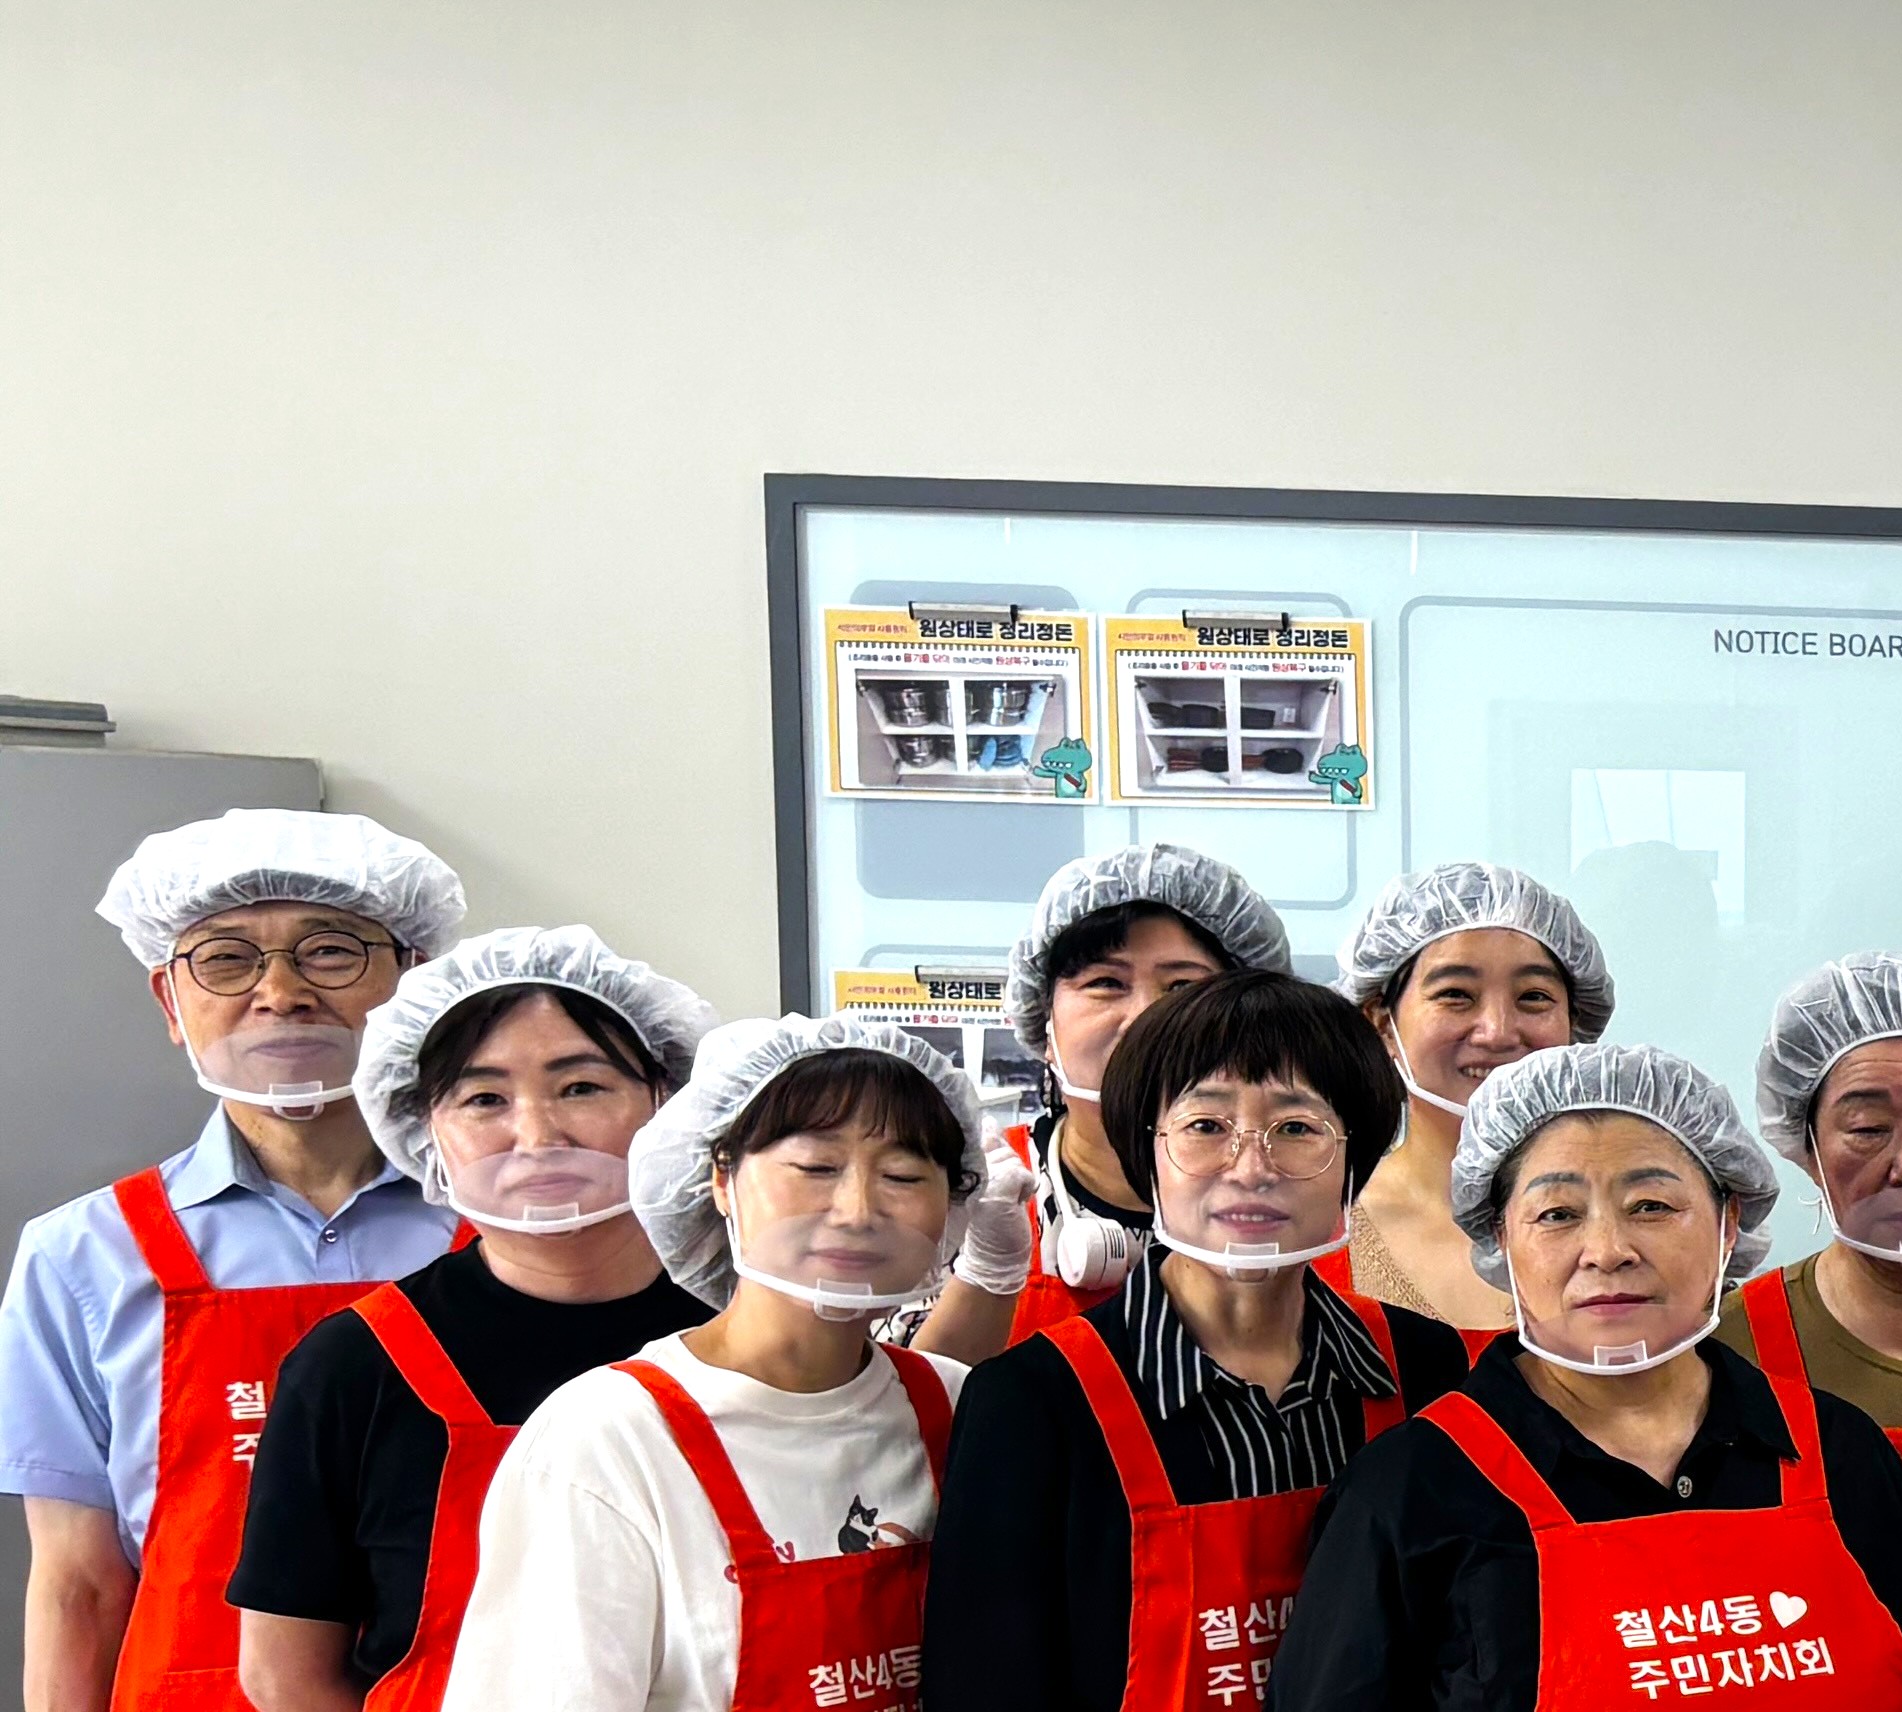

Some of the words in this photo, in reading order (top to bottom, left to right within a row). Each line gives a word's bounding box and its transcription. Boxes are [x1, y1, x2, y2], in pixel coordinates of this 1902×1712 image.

[919, 619, 994, 639] 원상태로
[999, 620, 1074, 642] 정리정돈
[1196, 627, 1271, 647] 원상태로
[1275, 628, 1349, 649] 정리정돈
[1713, 629, 1819, 656] NOTICE
[928, 981, 1003, 1000] 원상태로
[1613, 1595, 1764, 1649] 철산4동
[1628, 1636, 1836, 1700] 주민자치회
